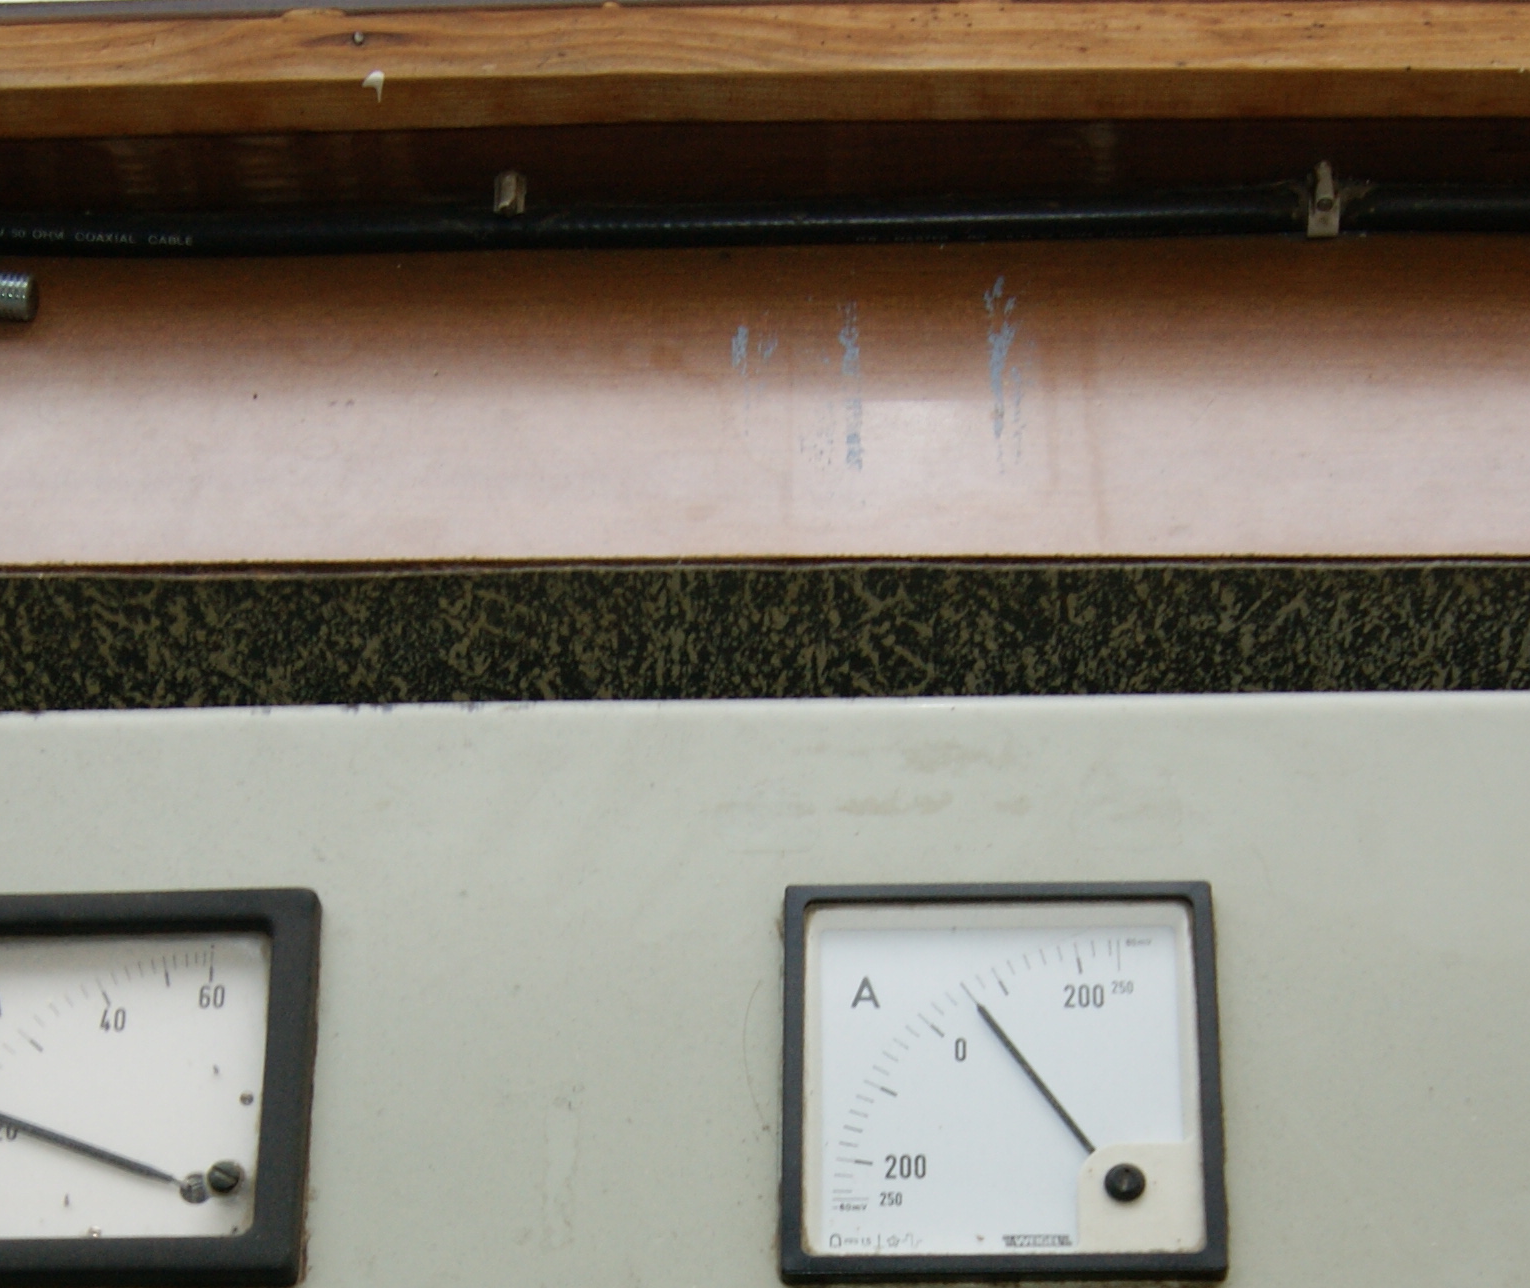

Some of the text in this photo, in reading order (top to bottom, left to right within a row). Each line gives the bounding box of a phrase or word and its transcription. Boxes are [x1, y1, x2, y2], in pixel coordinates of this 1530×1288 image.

[75, 232, 136, 244] COAXIAL
[148, 234, 193, 246] CABLE
[199, 985, 226, 1010] 60
[851, 976, 881, 1009] A
[1064, 984, 1105, 1008] 200
[1111, 981, 1134, 995] 250
[100, 1008, 127, 1033] 40
[954, 1038, 967, 1062] 0
[885, 1155, 927, 1180] 200
[879, 1192, 903, 1207] 250
